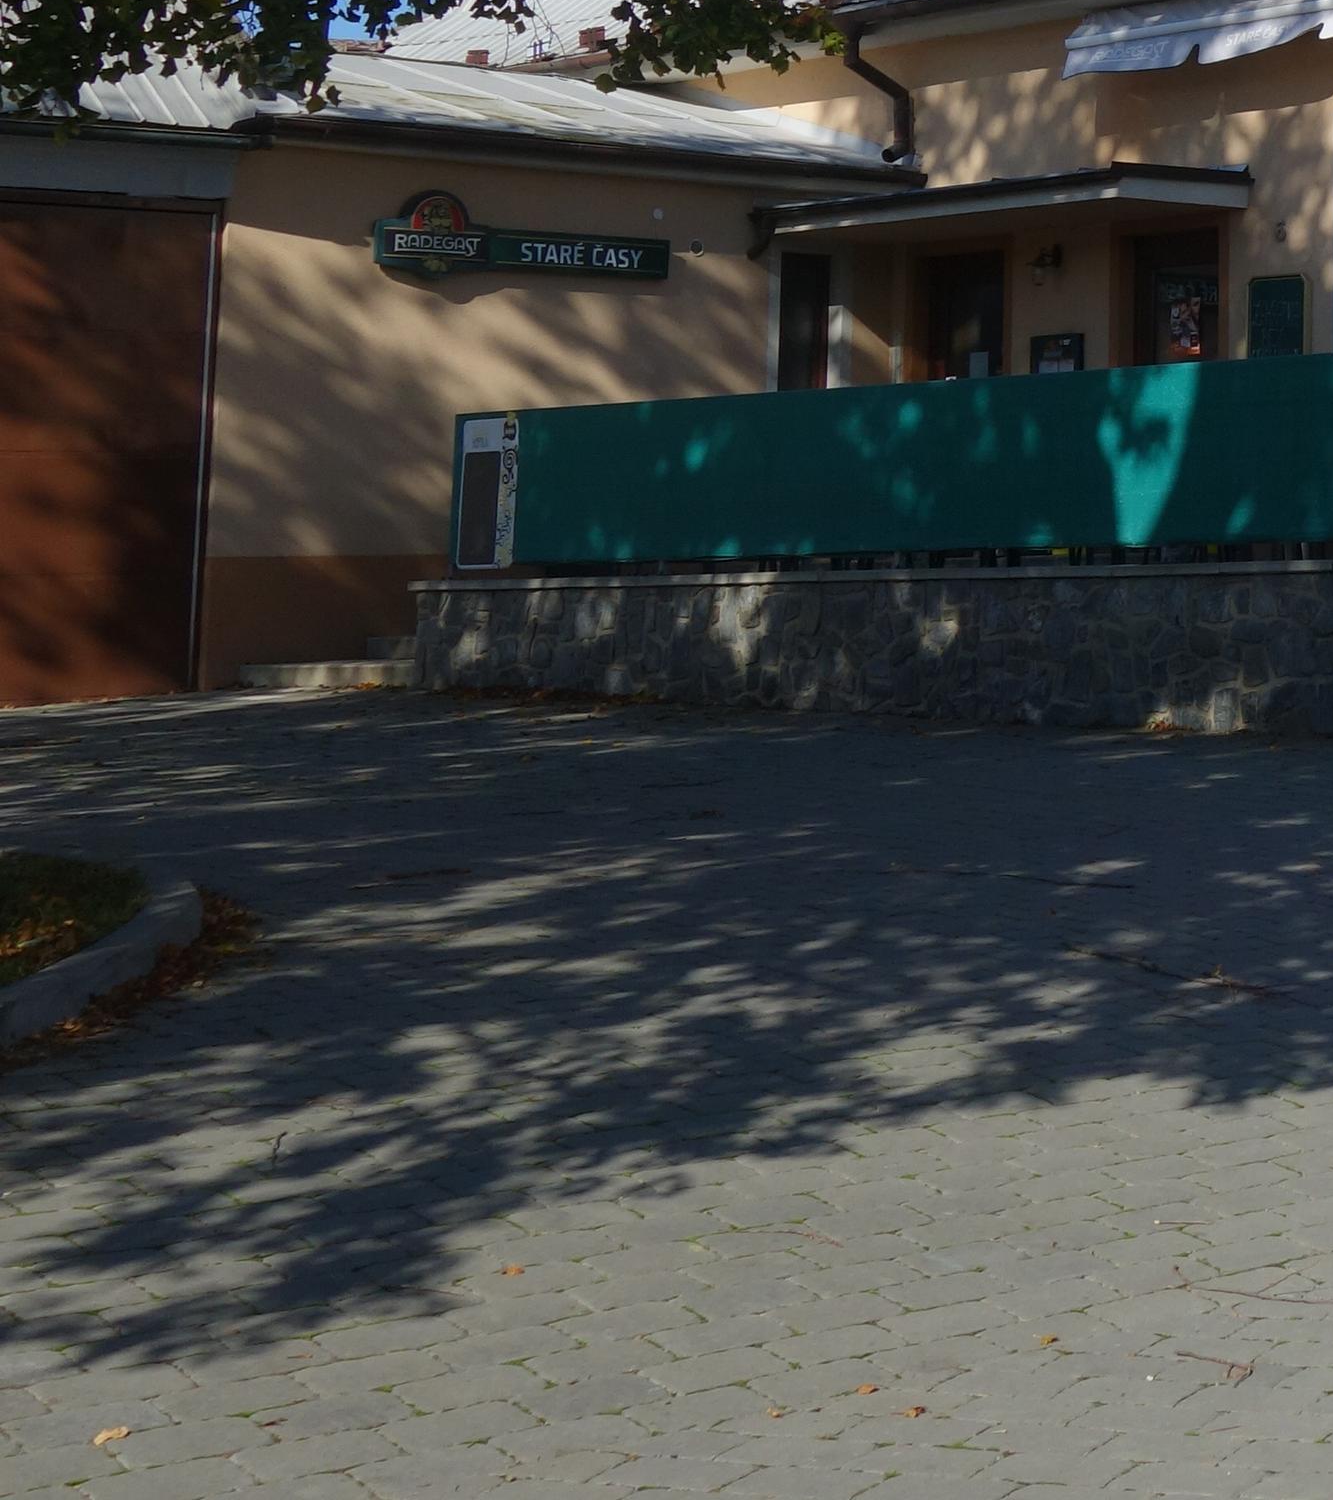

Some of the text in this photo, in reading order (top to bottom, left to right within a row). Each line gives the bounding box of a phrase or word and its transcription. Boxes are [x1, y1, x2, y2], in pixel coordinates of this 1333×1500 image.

[394, 233, 481, 257] RADEGAST
[520, 242, 643, 269] STARÉ ČASY
